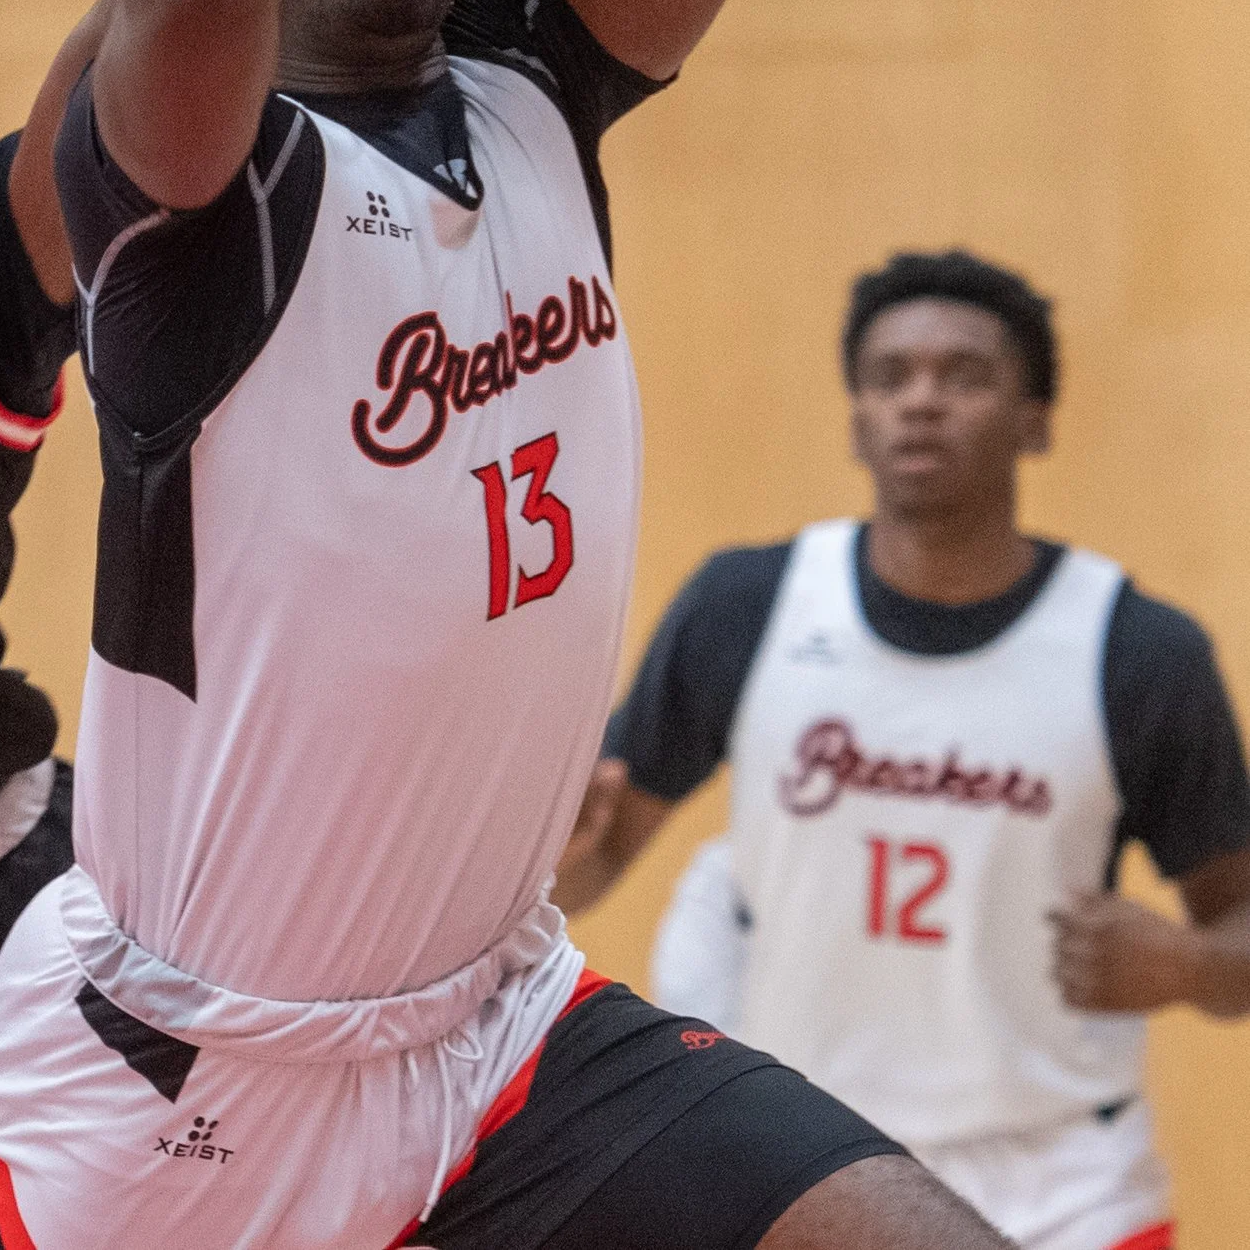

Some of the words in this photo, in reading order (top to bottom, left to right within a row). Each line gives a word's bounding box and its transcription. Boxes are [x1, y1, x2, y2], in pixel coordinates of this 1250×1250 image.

[346, 215, 413, 242] XEIST
[470, 431, 574, 622] 13
[779, 715, 1052, 820] Breakers
[866, 833, 950, 947] 12
[153, 1137, 234, 1164] XEIST
